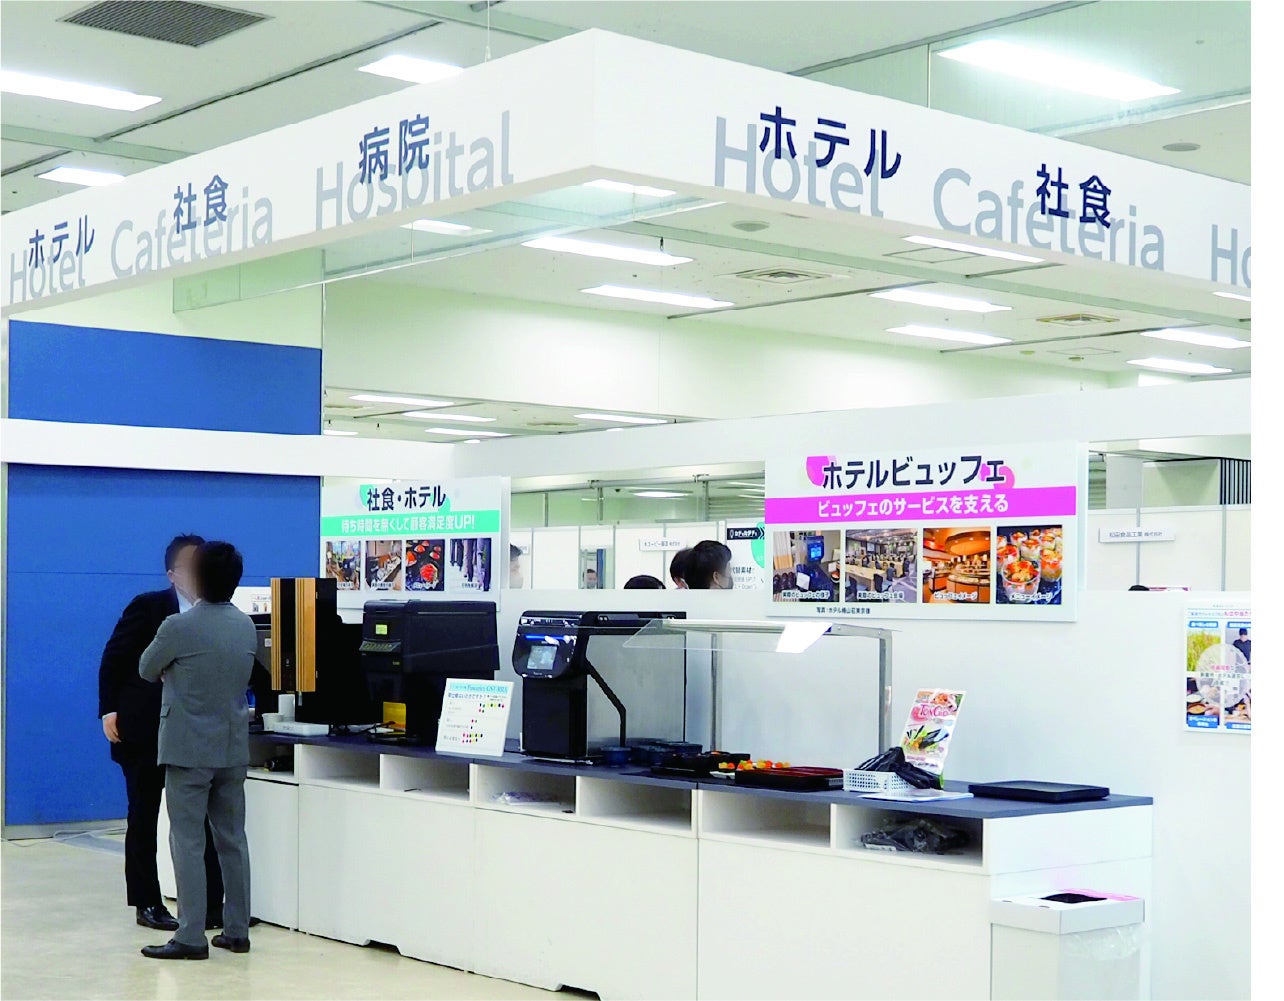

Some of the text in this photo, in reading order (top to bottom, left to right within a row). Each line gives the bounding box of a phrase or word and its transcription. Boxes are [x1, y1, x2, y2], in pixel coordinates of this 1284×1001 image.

[316, 110, 514, 231] Hospital
[359, 114, 431, 184] 病院
[714, 116, 884, 218] Hotel
[759, 105, 902, 180] ホテル
[173, 174, 229, 234] 社食
[932, 168, 1165, 273] Cafeteria
[1036, 163, 1112, 229] 社食
[28, 214, 95, 269] ホテル
[111, 186, 273, 279] Cafeteria
[10, 246, 85, 304] Hotel
[367, 485, 446, 512] 社食・ホテル
[822, 455, 1005, 489] ホテルビュッフェ
[818, 494, 1009, 518] ビュッフェのサービスを支える
